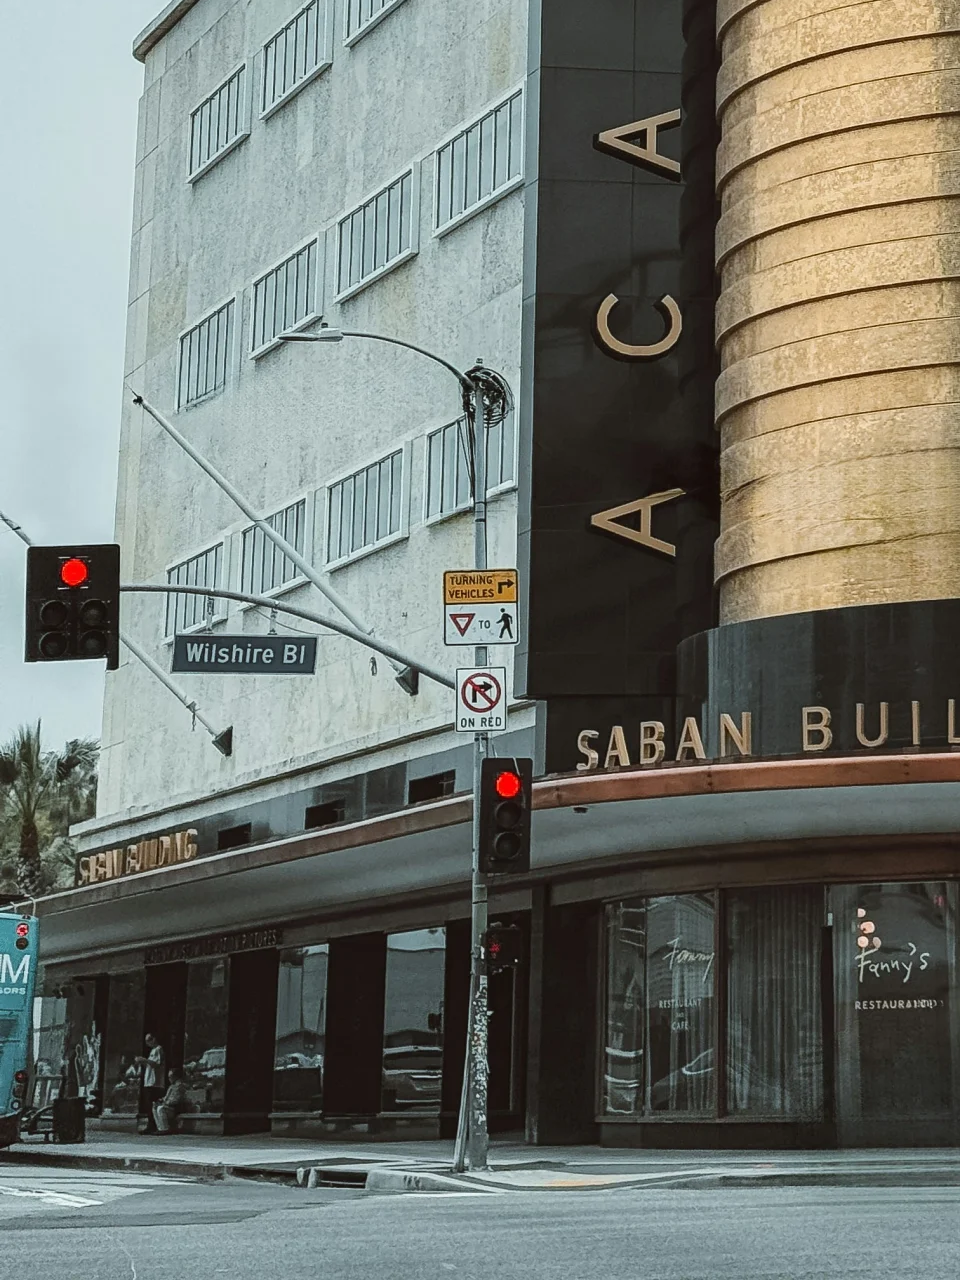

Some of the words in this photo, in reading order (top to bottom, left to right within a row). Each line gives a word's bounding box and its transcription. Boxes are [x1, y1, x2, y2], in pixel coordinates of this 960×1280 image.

[449, 576, 493, 585] TURNING
[448, 589, 494, 598] VEHICLES
[478, 620, 490, 629] TO
[186, 643, 274, 663] Wilshire
[283, 644, 305, 664] Bl
[461, 718, 475, 728] ON
[481, 717, 501, 727] RED
[576, 711, 753, 771] SABAN
[0, 954, 30, 984] M
[854, 942, 930, 983] Fanny's
